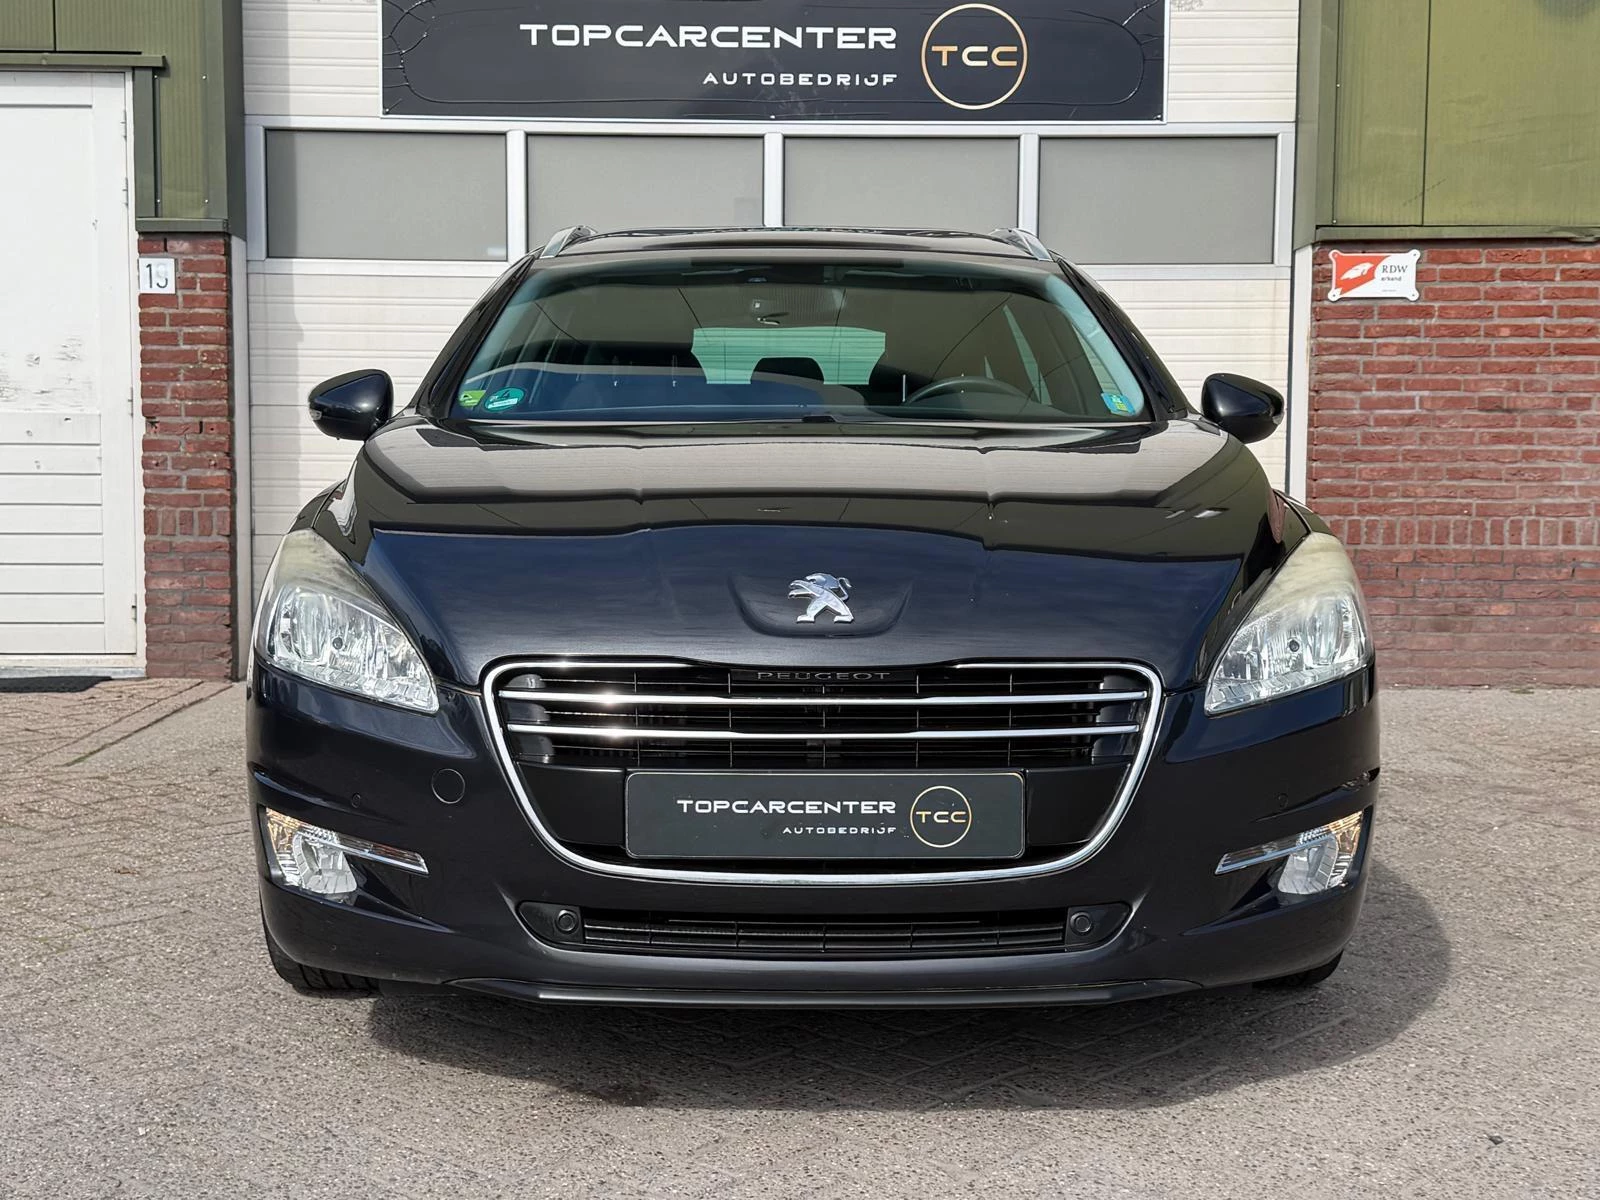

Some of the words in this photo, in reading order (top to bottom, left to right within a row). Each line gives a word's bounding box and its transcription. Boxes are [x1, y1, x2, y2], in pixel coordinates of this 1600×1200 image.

[519, 24, 897, 49] TOPCARCENTER
[931, 45, 1018, 67] TCC
[703, 72, 898, 86] AUTOBEDRIJF
[1381, 264, 1408, 273] RDW
[757, 672, 891, 680] PEUGEOT
[677, 799, 896, 814] TOPCARCENTER
[916, 811, 967, 823] TCC
[782, 827, 897, 835] AUTOBEDRIJF
